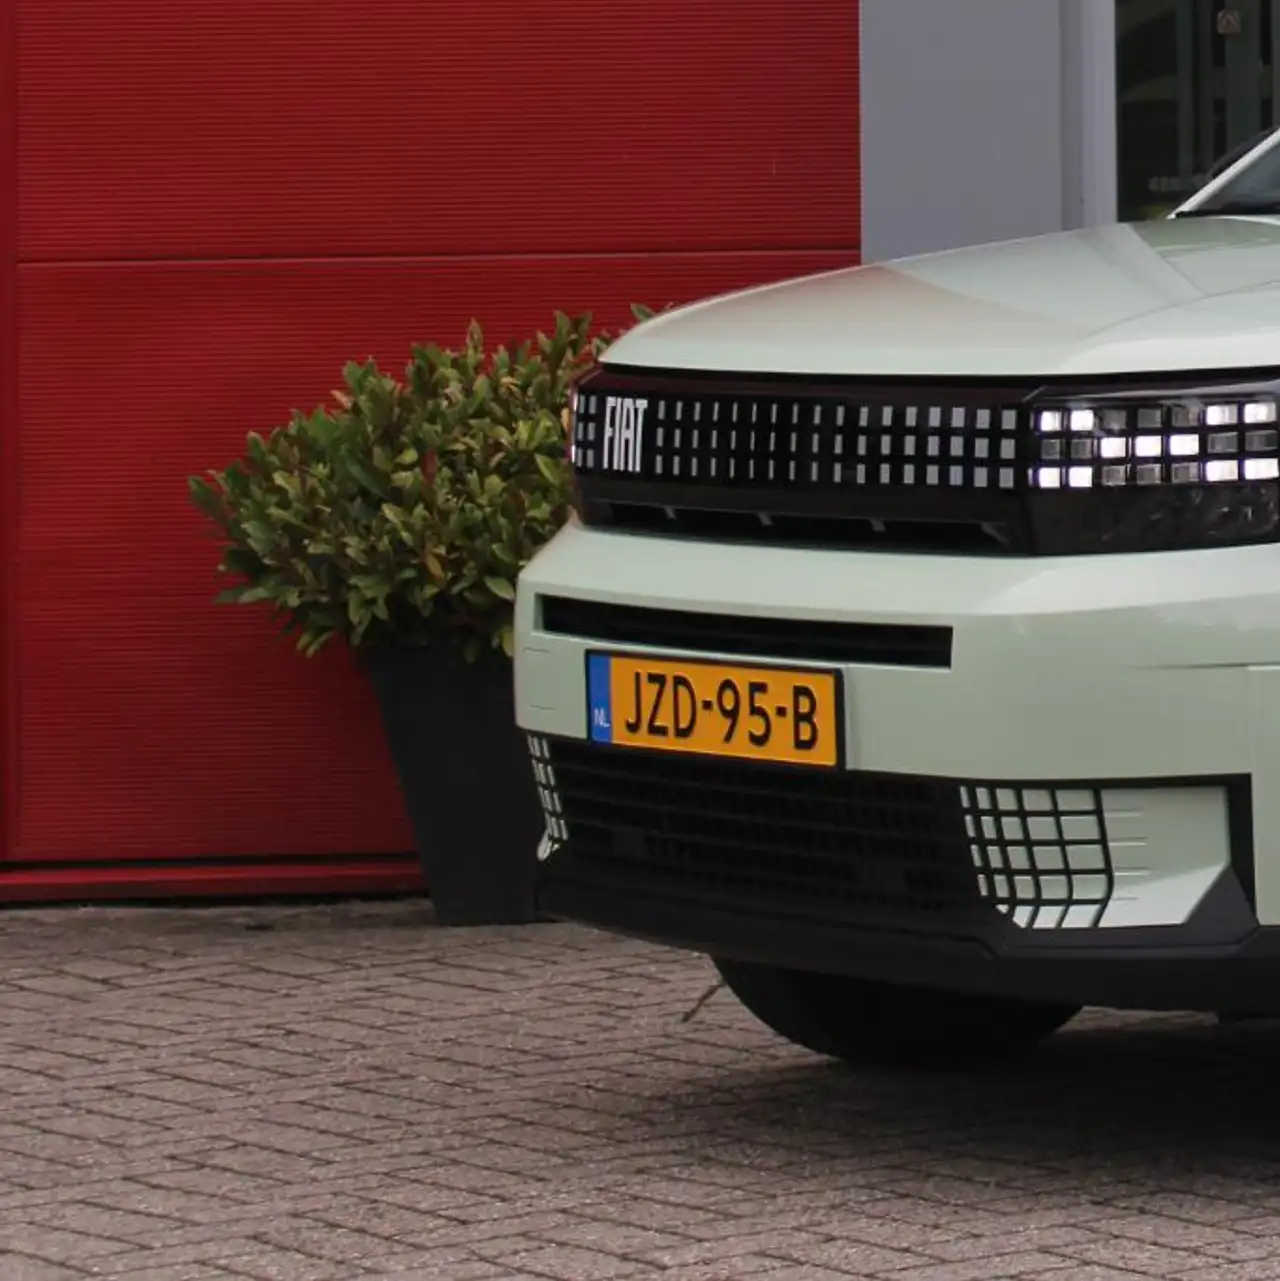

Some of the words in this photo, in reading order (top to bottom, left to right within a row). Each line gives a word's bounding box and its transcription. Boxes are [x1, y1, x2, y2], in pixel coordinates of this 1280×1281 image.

[603, 396, 648, 472] FIAT
[593, 707, 611, 728] NL
[625, 671, 819, 750] JZD-95-B
